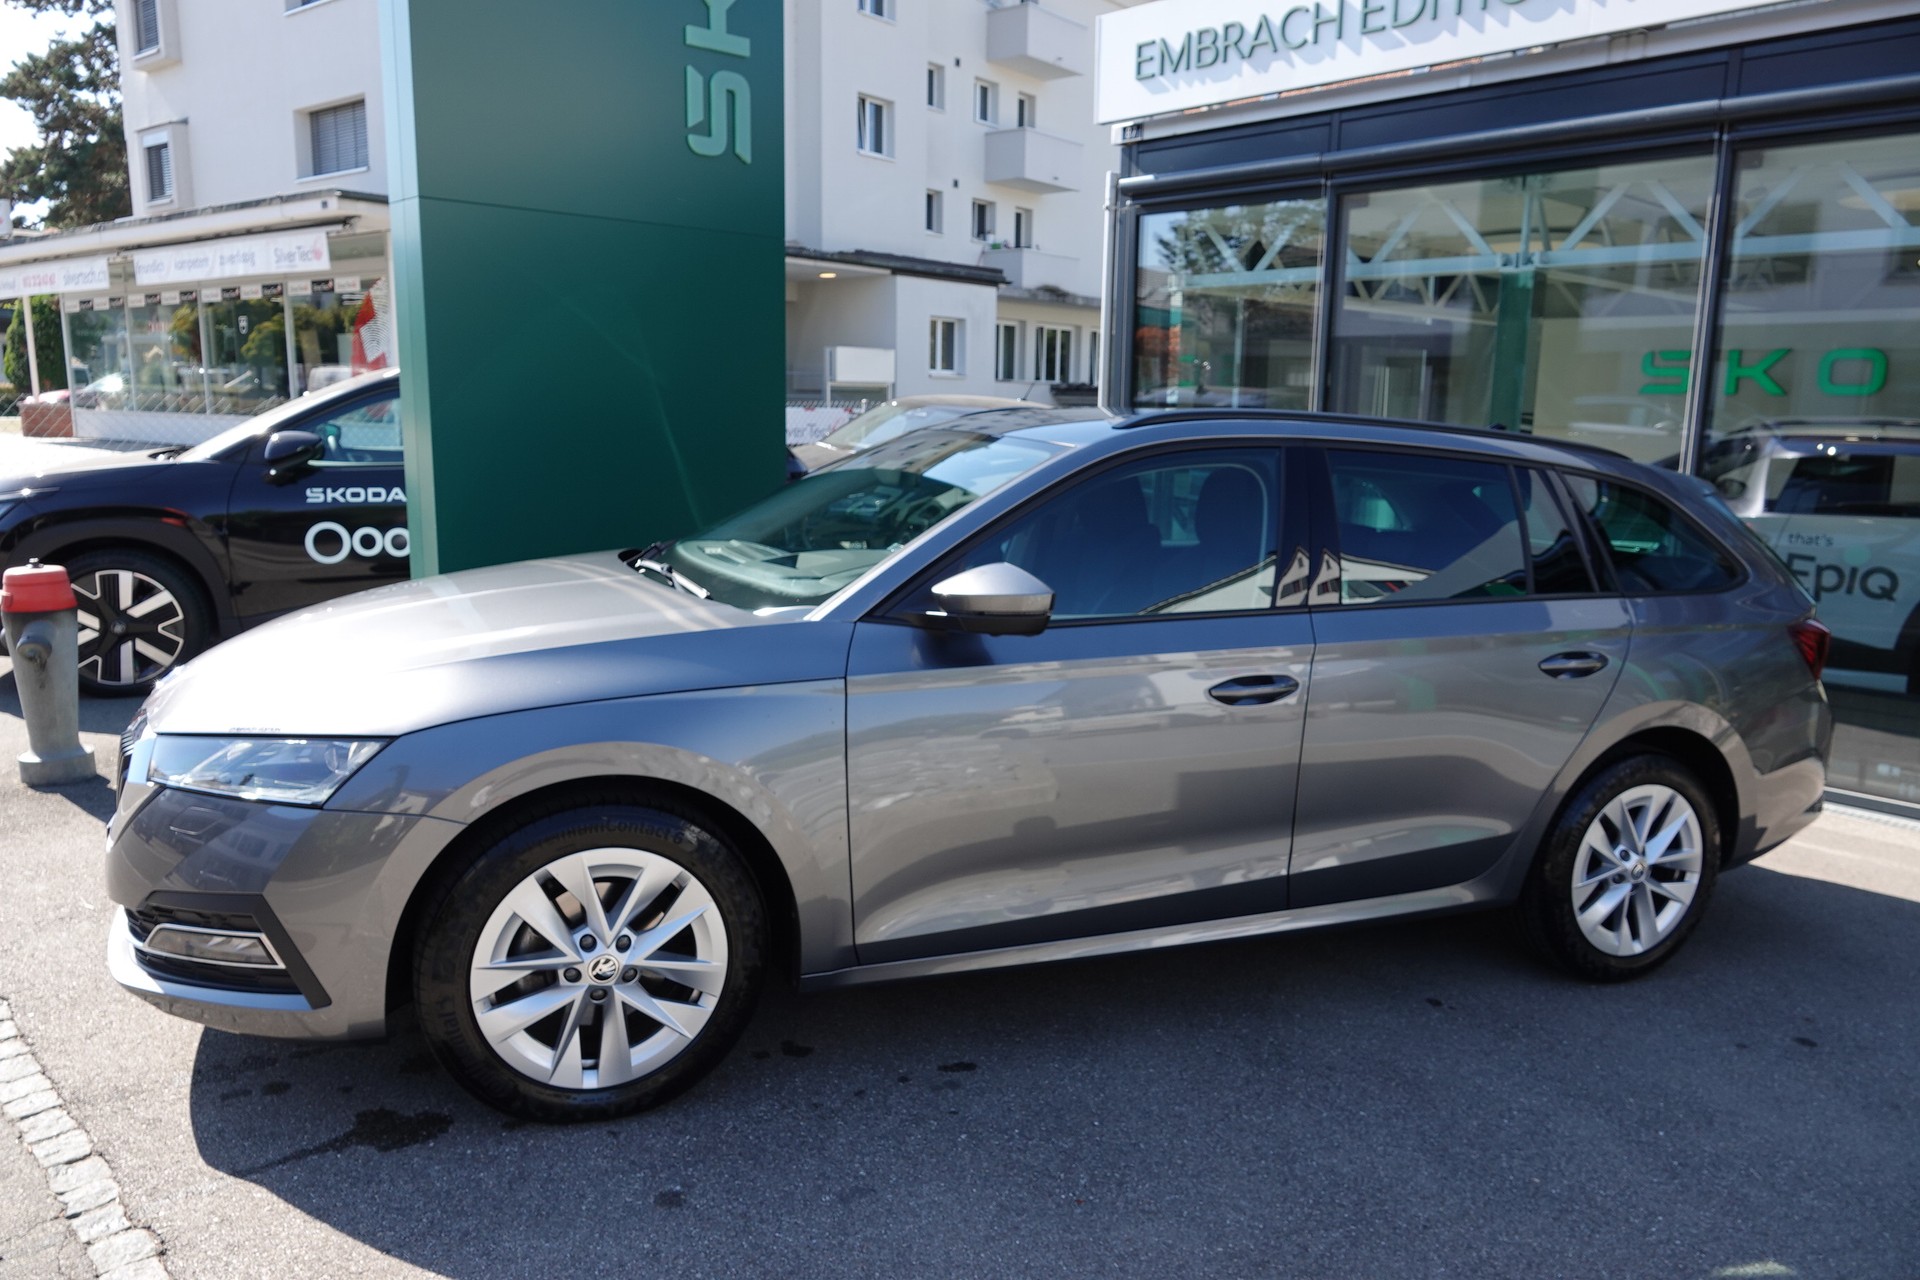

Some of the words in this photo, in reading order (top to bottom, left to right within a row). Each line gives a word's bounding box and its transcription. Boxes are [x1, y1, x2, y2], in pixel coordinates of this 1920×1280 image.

[1135, 0, 1345, 81] EMBRACH
[1638, 347, 1889, 396] SKO
[305, 486, 407, 503] SKODA
[1788, 532, 1834, 547] that's
